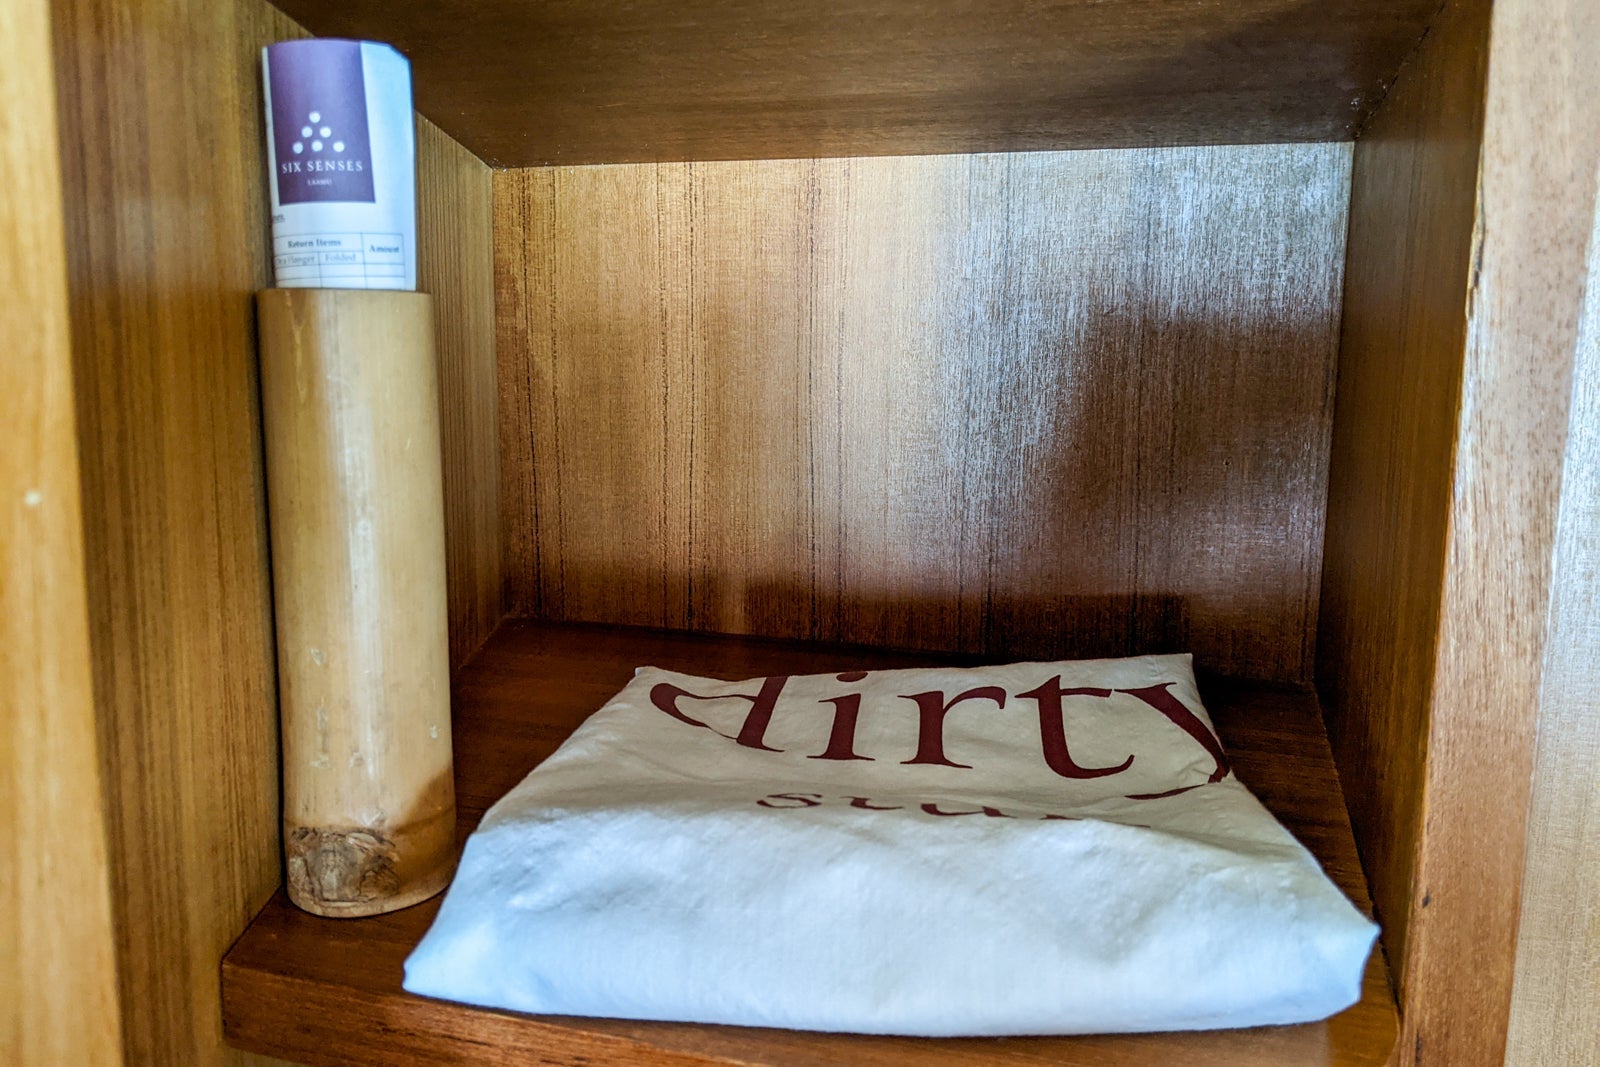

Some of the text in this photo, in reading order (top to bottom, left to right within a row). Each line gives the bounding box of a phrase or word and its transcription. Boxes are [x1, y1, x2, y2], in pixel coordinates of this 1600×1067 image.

[281, 160, 363, 174] SIX SENSES
[287, 238, 342, 249] Return Items
[369, 244, 399, 253] Amount
[649, 671, 1231, 801] dirty
